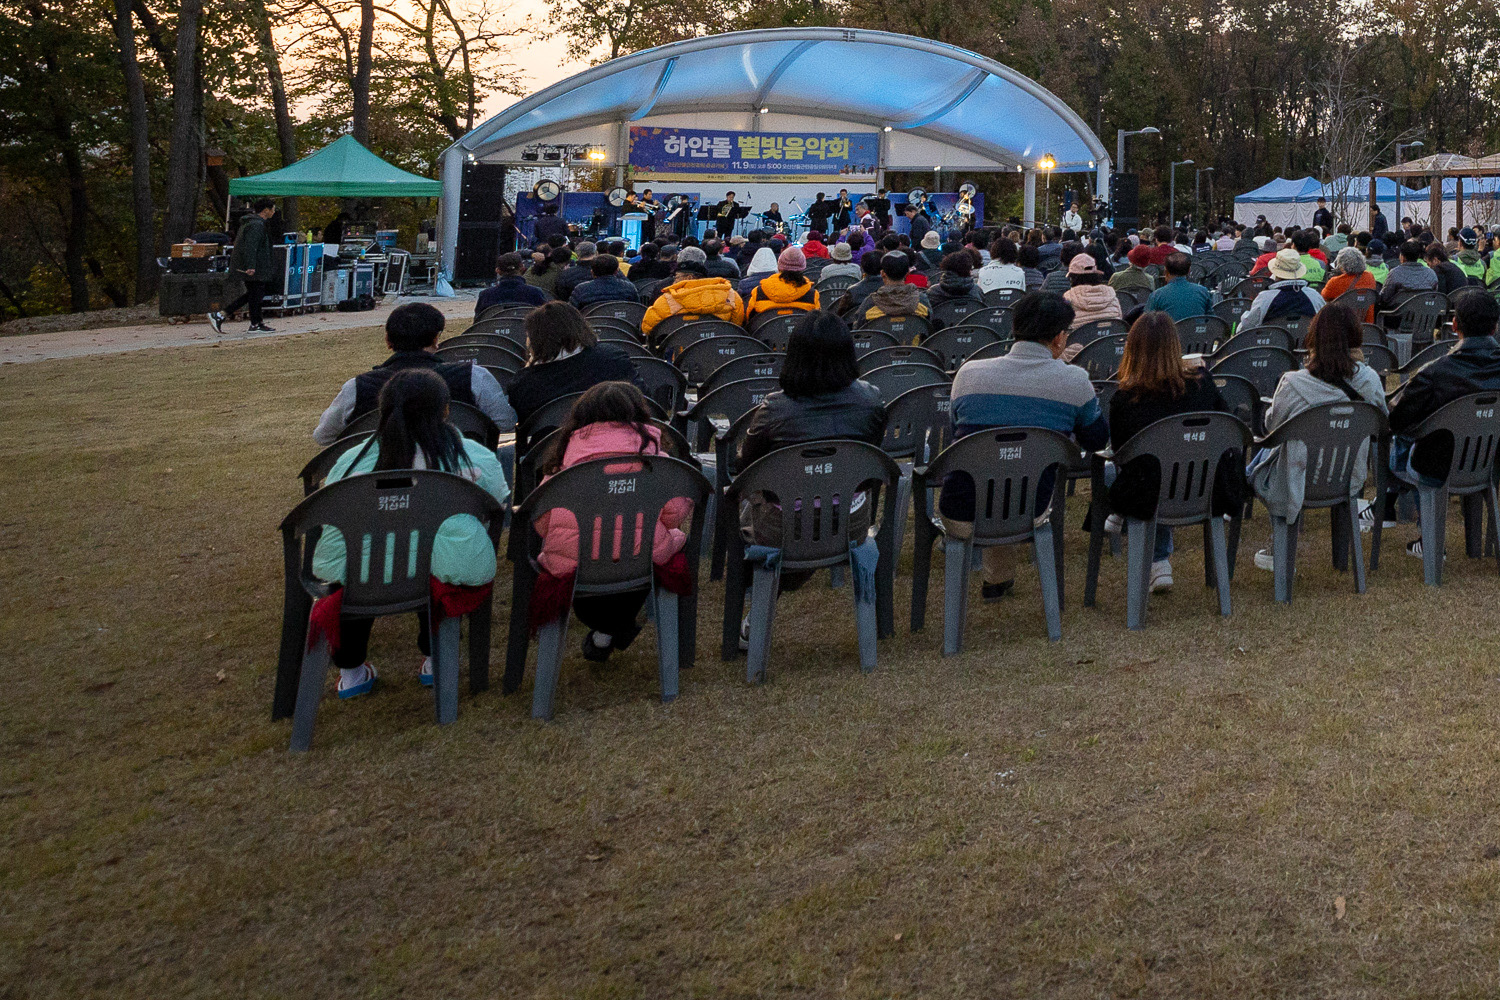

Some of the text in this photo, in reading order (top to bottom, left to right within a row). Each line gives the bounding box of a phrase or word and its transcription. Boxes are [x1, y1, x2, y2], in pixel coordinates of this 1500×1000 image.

[664, 135, 848, 160] 하얀돌 별빛음악회
[767, 162, 782, 170] 5:00
[754, 367, 773, 375] 백석읍
[1475, 408, 1494, 418] 백석읍
[1330, 419, 1350, 429] 백석읍
[1183, 431, 1206, 442] 백석읍
[804, 462, 833, 475] 백석읍
[608, 478, 636, 487] 양주시
[608, 485, 636, 494] 기산리
[378, 494, 410, 503] 양주시
[378, 501, 410, 511] 기산리
